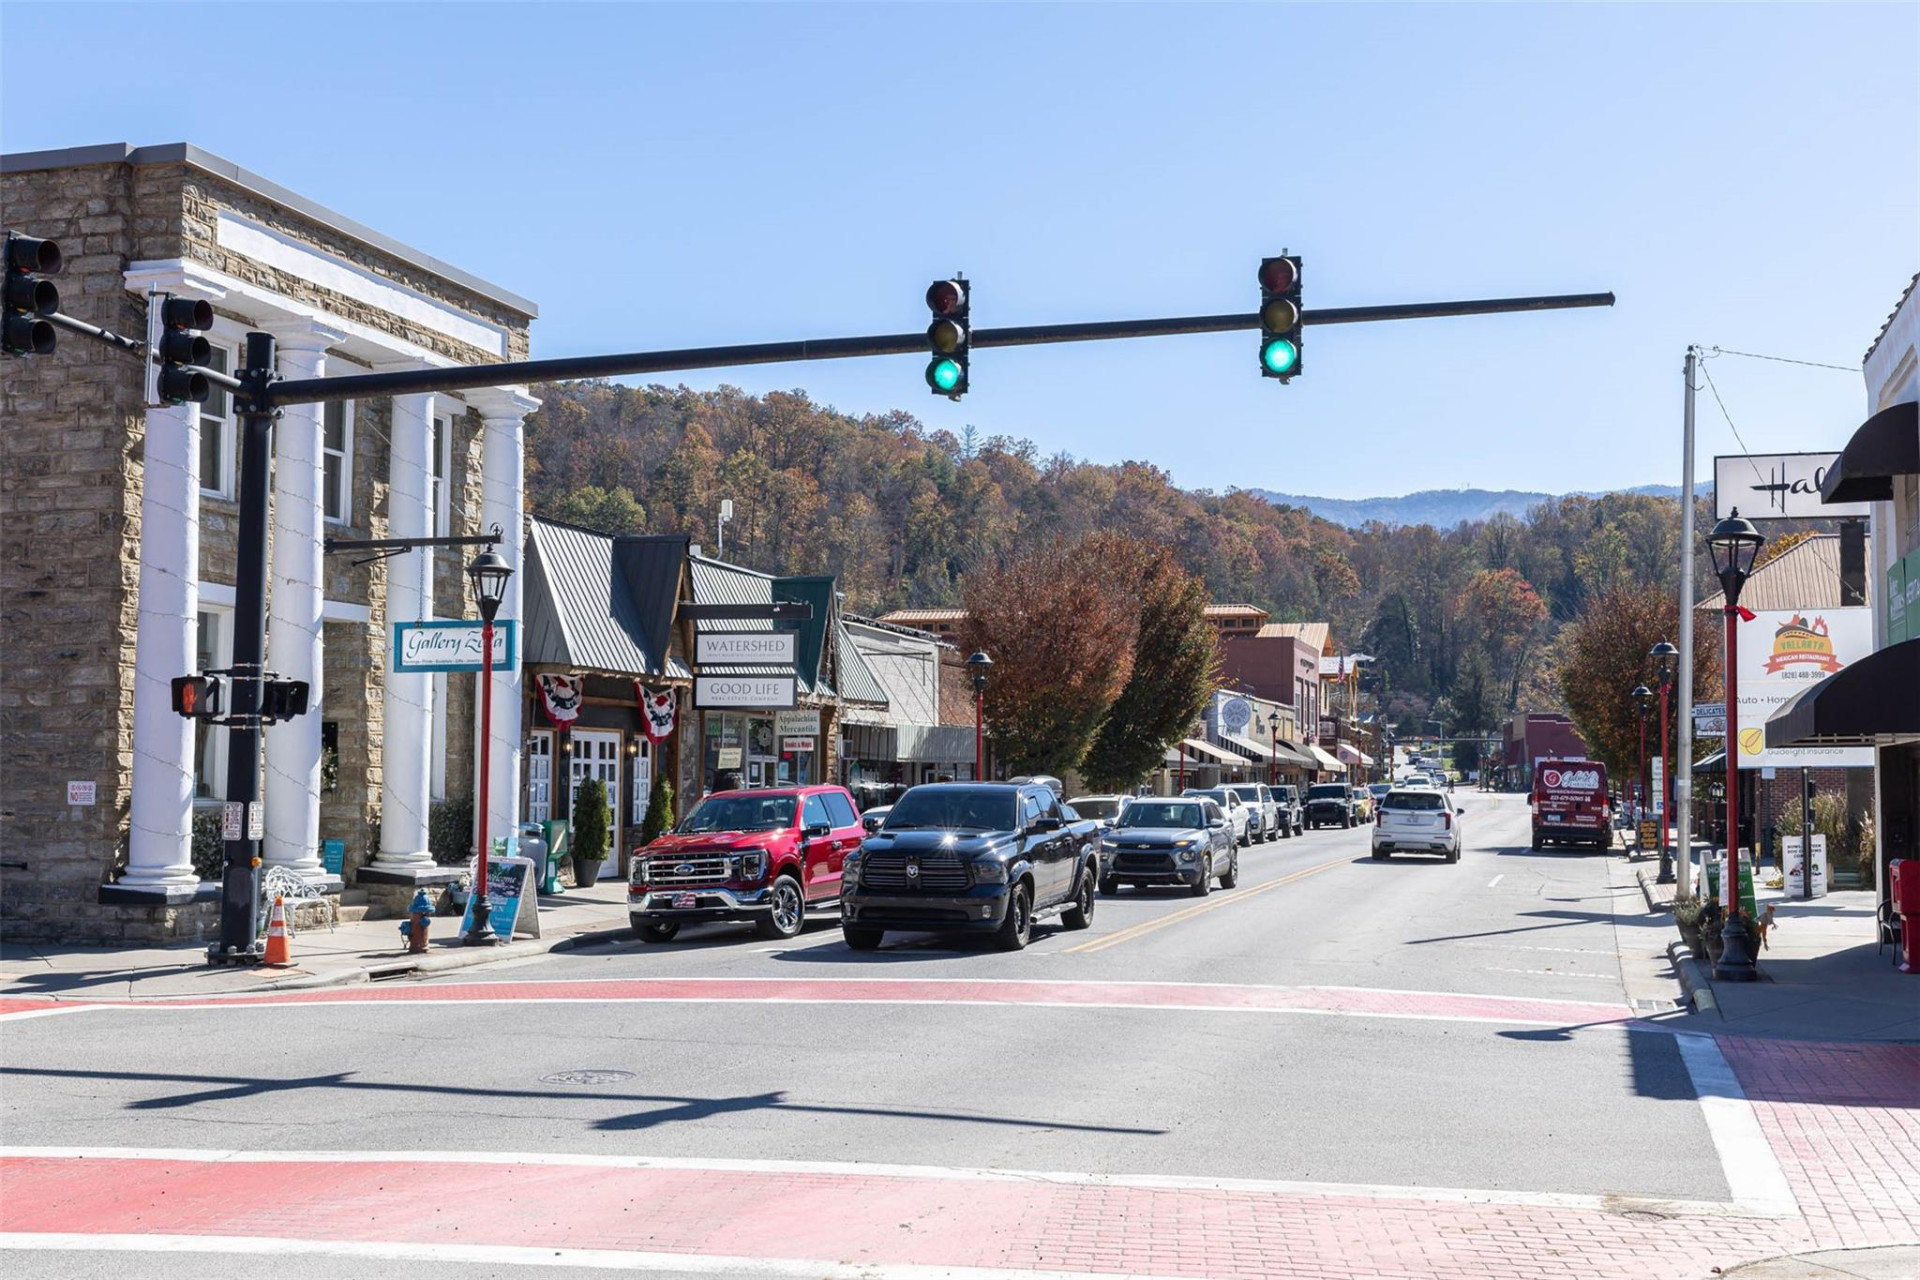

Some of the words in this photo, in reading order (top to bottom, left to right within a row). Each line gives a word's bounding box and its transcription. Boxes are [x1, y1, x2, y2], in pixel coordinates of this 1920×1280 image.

[406, 631, 461, 658] Gallery
[465, 630, 503, 653] Zla
[706, 640, 785, 652] WATERSHED
[1781, 640, 1825, 650] VALLARTA
[1775, 654, 1799, 662] MEXICAN
[1799, 653, 1830, 662] RESTAURANT
[710, 683, 752, 695] GOOD
[755, 683, 779, 695] LIFE
[1736, 696, 1758, 705] Auto
[1767, 696, 1790, 704] Hom
[1696, 708, 1726, 716] DELICATES
[778, 714, 817, 724] Appalachian
[780, 724, 817, 733] Mercantile
[801, 741, 812, 749] Maps
